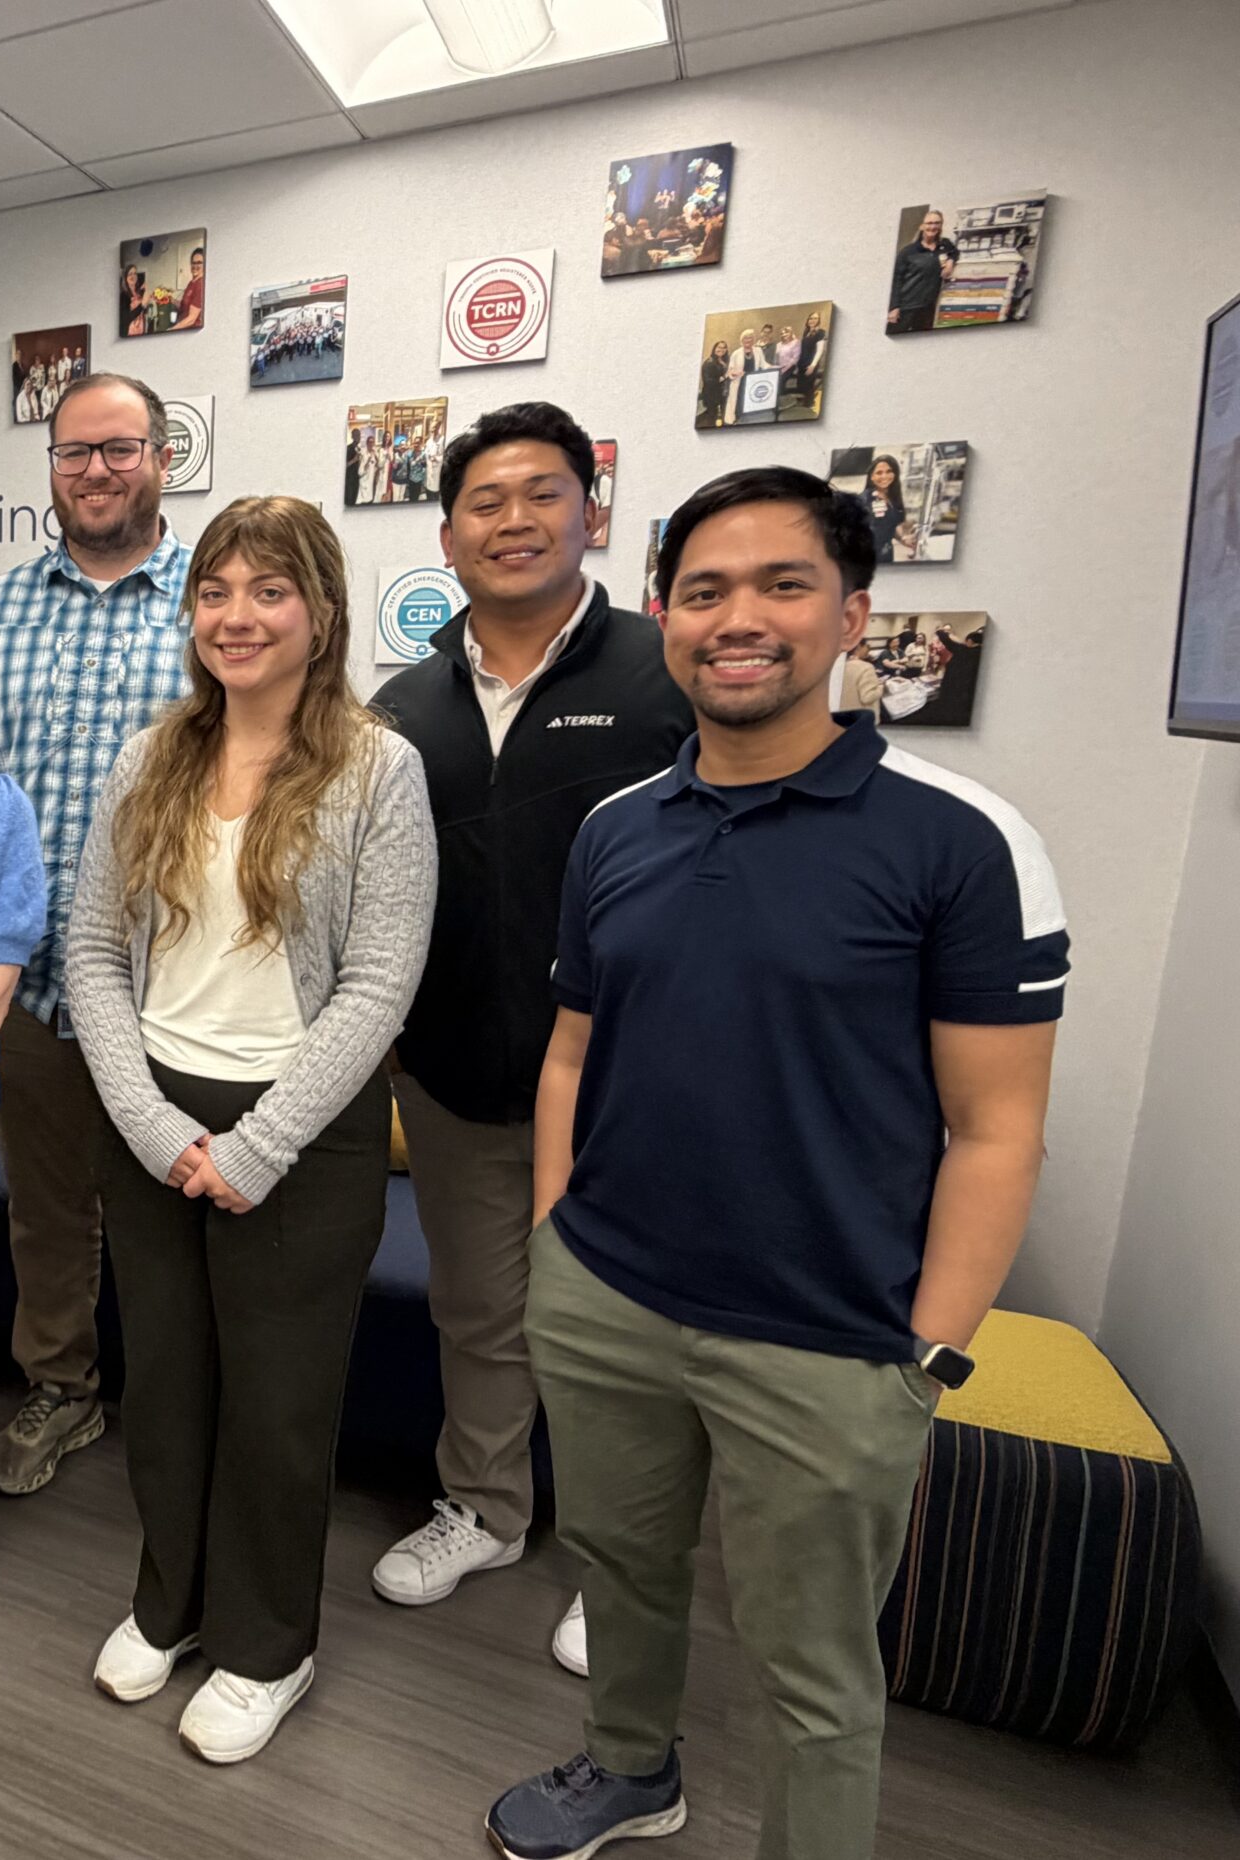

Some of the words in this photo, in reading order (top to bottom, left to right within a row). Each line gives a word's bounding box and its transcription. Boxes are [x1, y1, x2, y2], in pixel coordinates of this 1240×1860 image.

[471, 300, 521, 320] TCRN
[406, 607, 442, 622] CEN
[563, 714, 615, 727] TERREX
